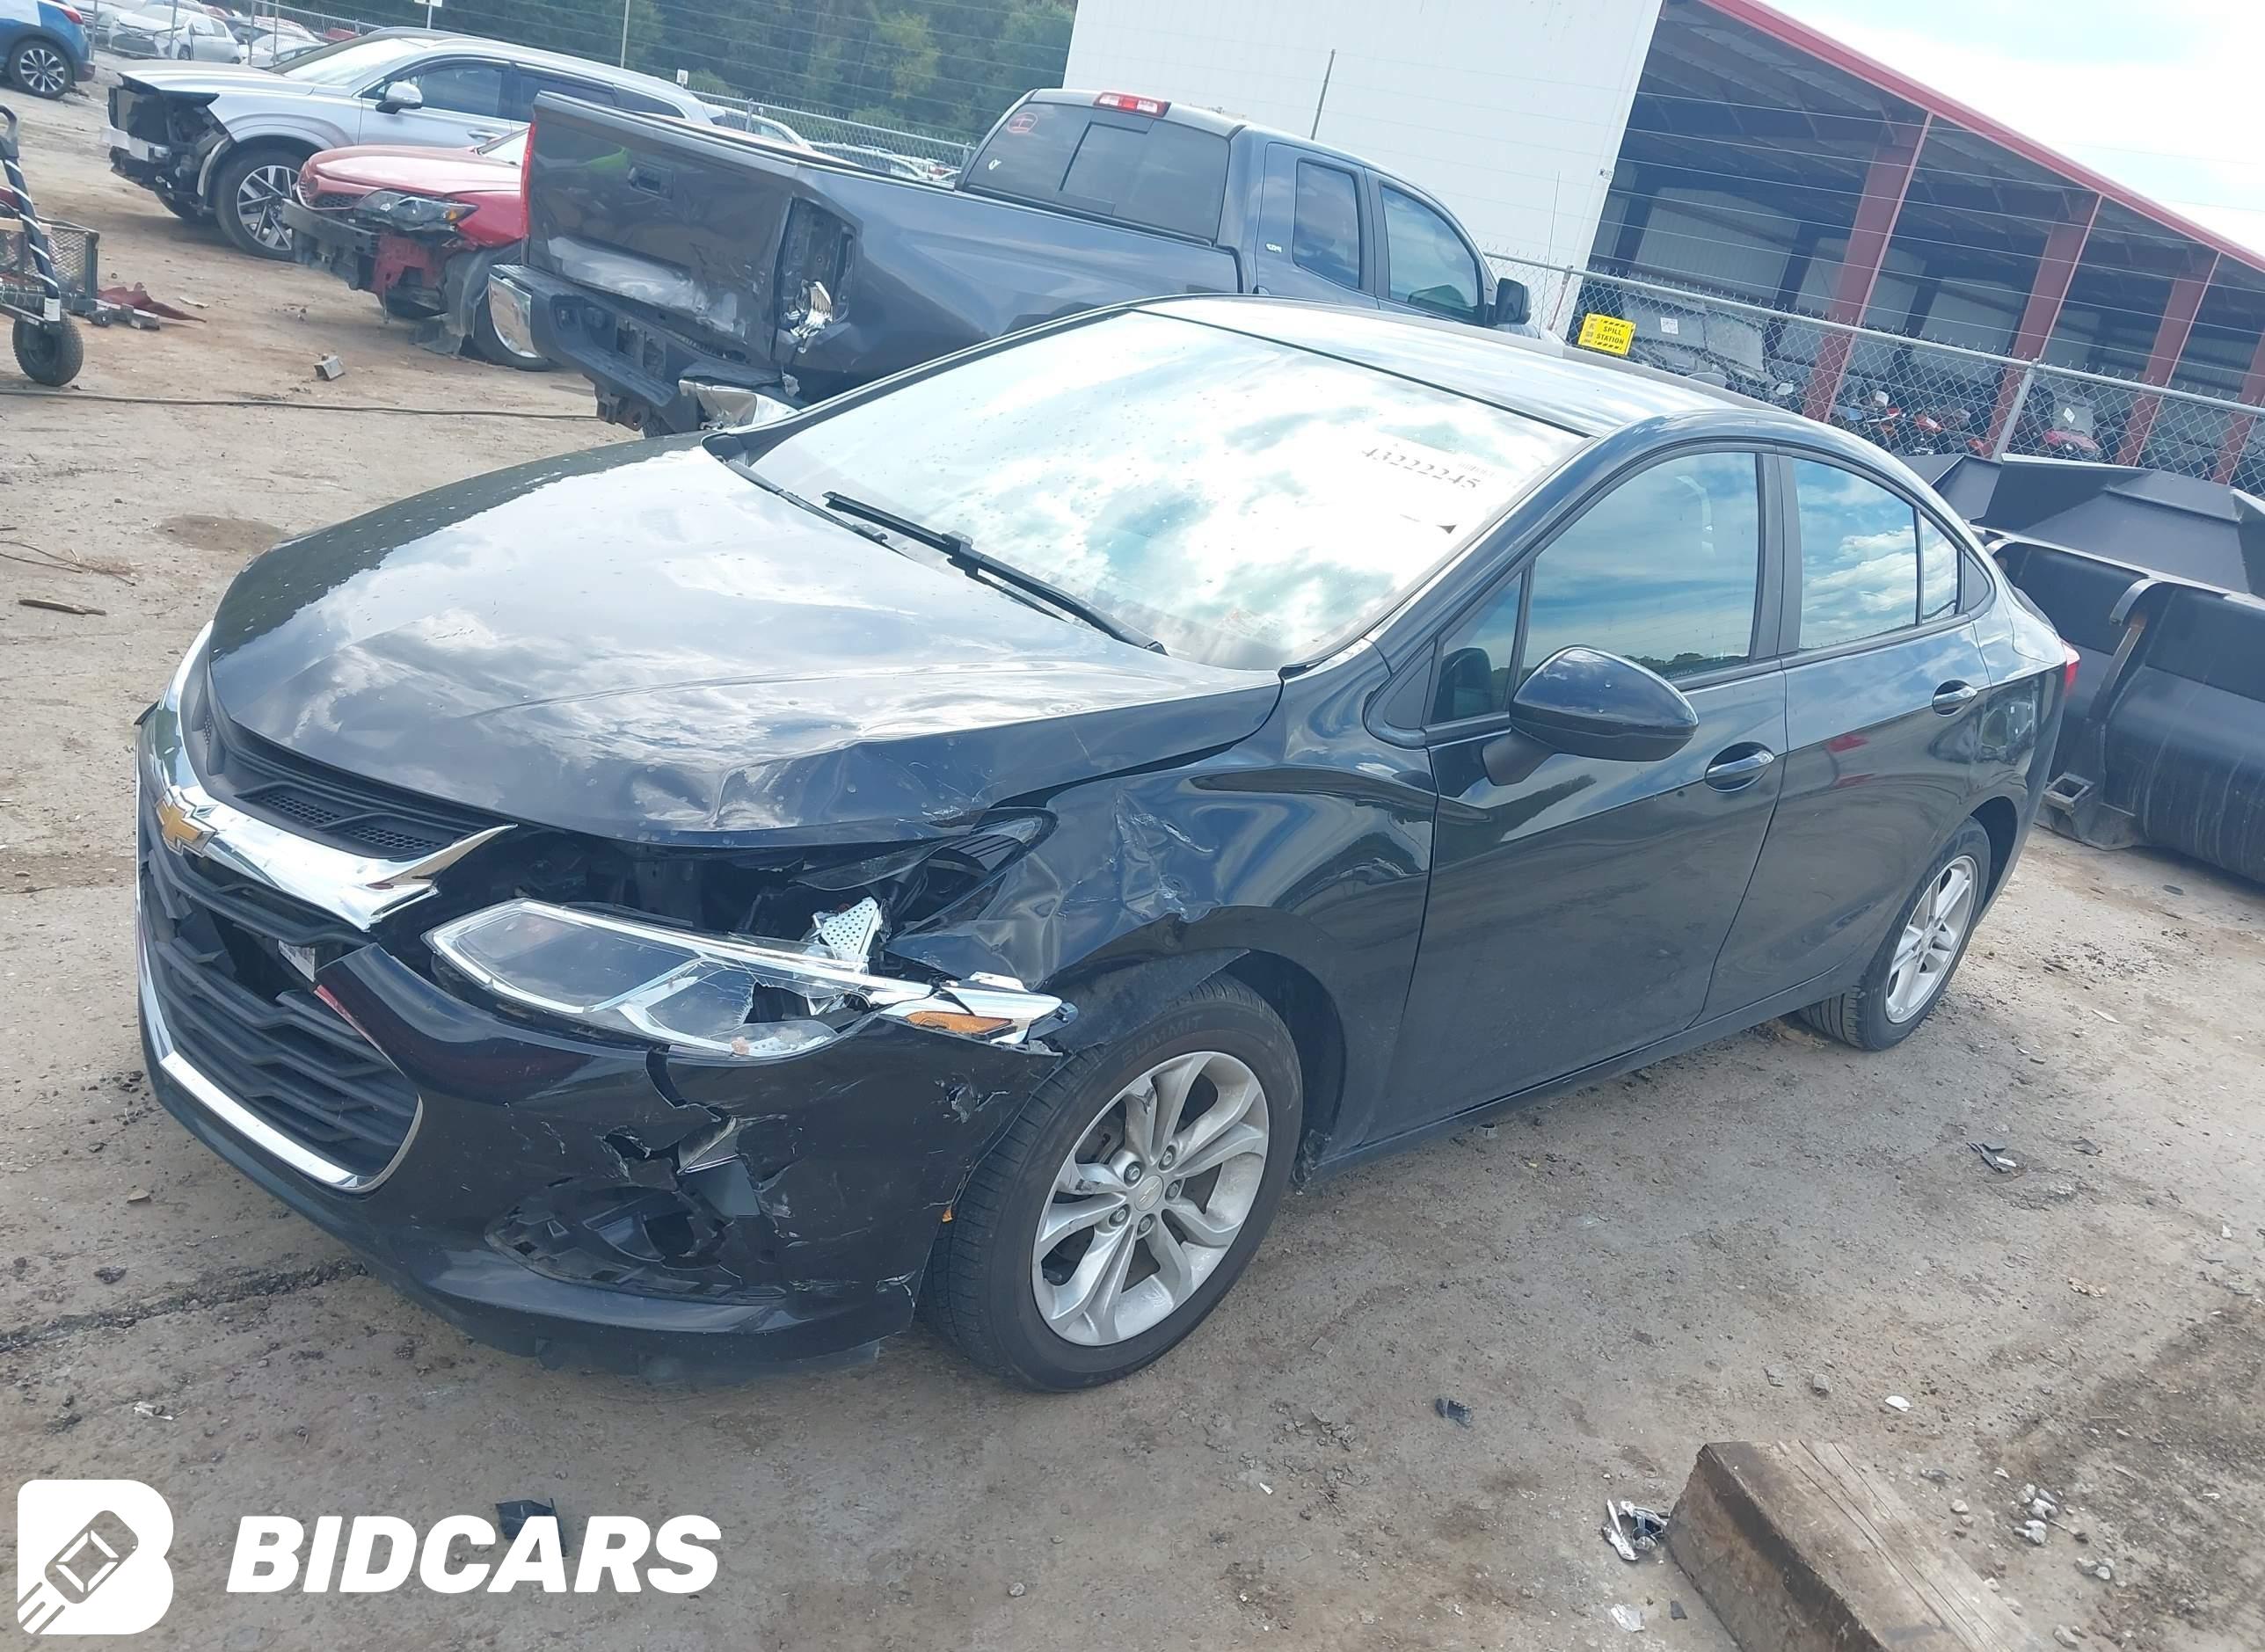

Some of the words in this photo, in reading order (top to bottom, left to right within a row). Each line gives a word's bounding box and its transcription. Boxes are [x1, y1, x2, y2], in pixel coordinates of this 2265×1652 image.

[1604, 326, 1622, 335] SPILL
[1596, 333, 1625, 344] STATION
[1122, 1015, 1204, 1067] SUMMIT
